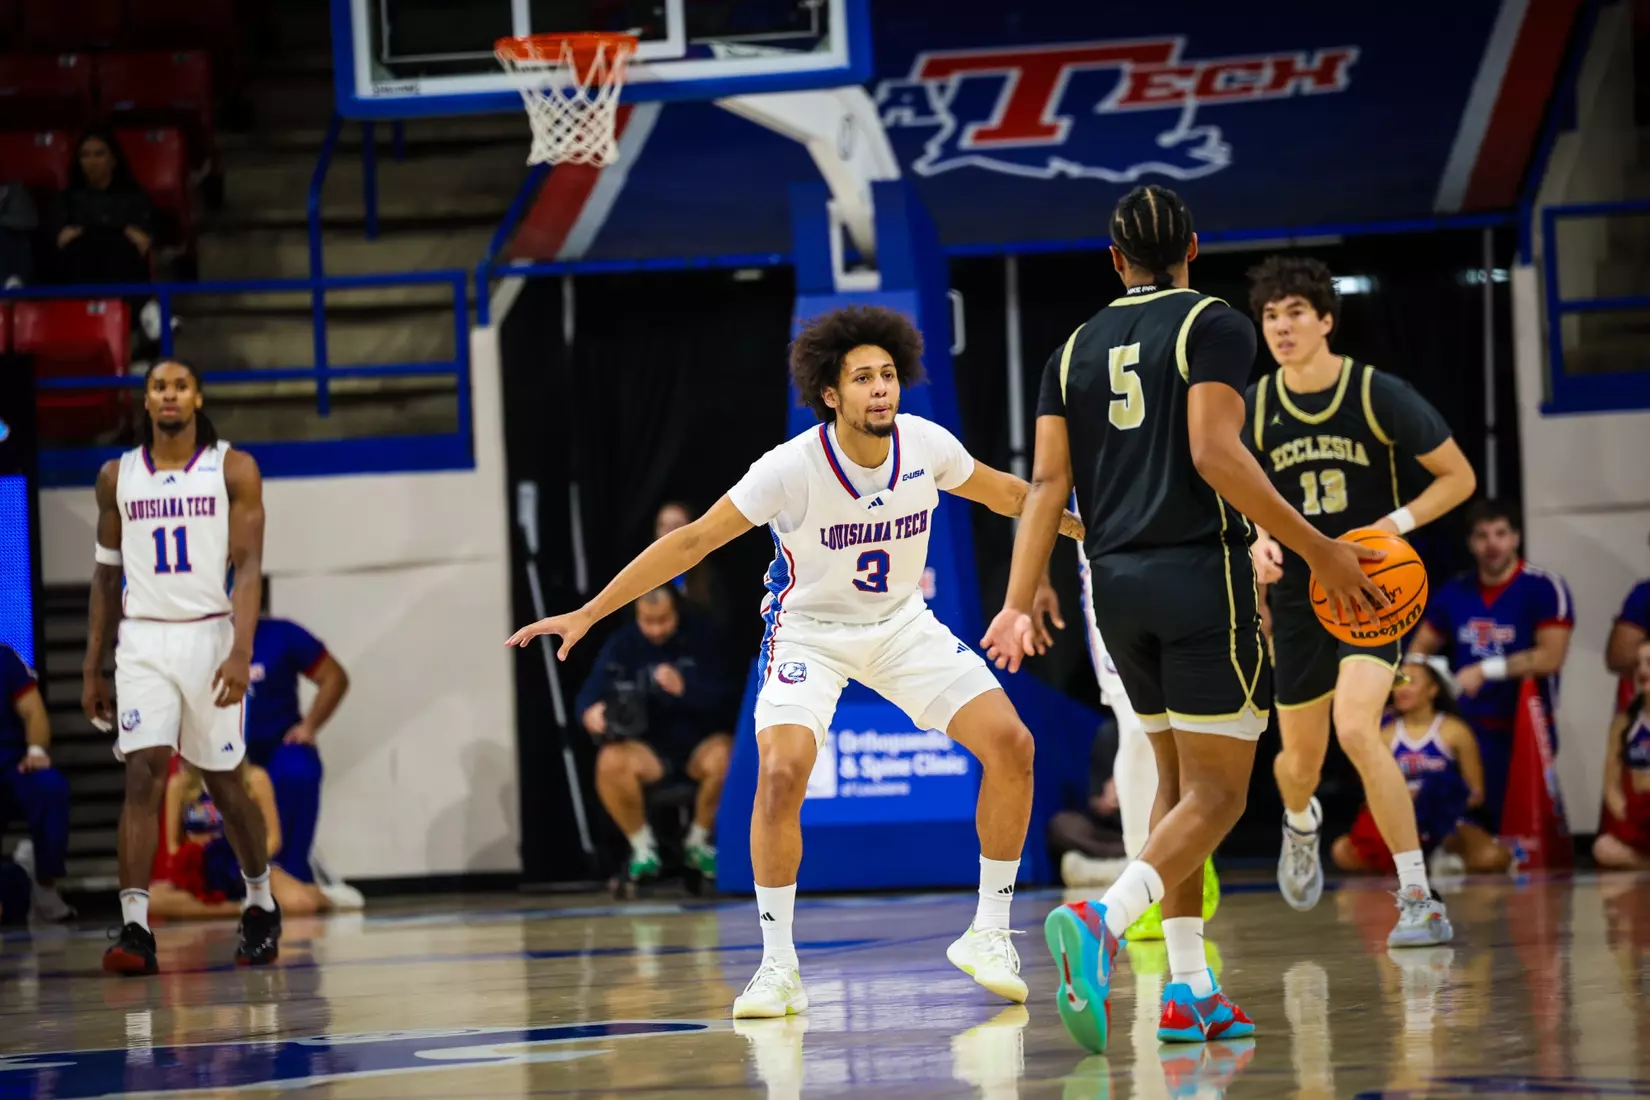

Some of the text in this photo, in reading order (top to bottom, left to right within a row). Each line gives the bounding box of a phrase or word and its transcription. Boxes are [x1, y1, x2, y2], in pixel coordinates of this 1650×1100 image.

[909, 36, 1361, 150] TECH
[1108, 342, 1145, 431] 5
[1269, 434, 1370, 472] ECCLESIA
[125, 496, 216, 522] LOUISIANA TECH
[1300, 468, 1348, 515] 13
[152, 525, 192, 575] 11
[820, 509, 928, 551] LOUISIANA TECH
[852, 549, 890, 593] 3
